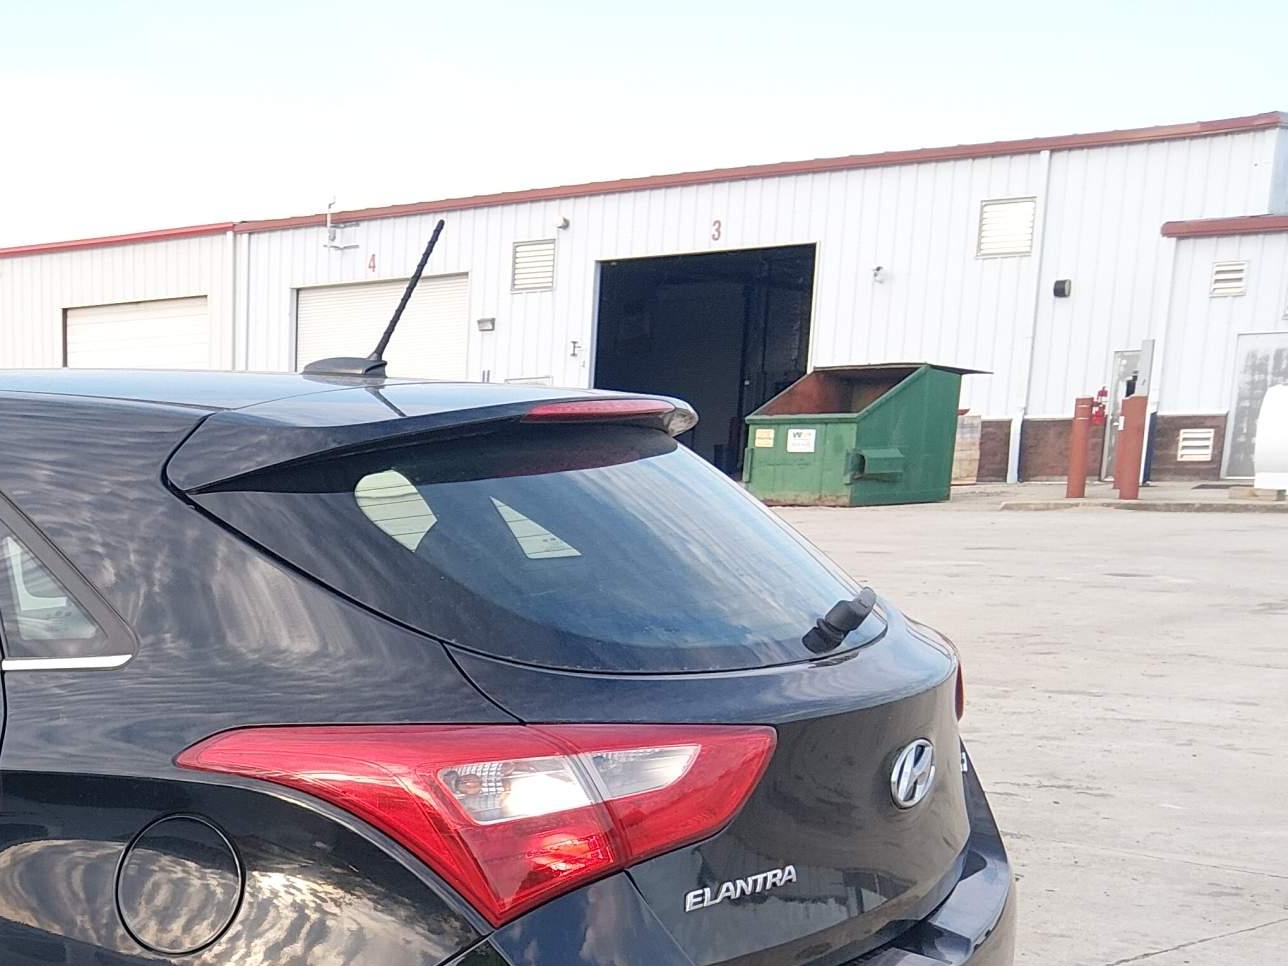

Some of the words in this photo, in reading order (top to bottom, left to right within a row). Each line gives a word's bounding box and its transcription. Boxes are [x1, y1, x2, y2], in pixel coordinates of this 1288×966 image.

[712, 219, 721, 241] 3
[368, 253, 376, 273] 4
[685, 864, 797, 912] ELANTRA
